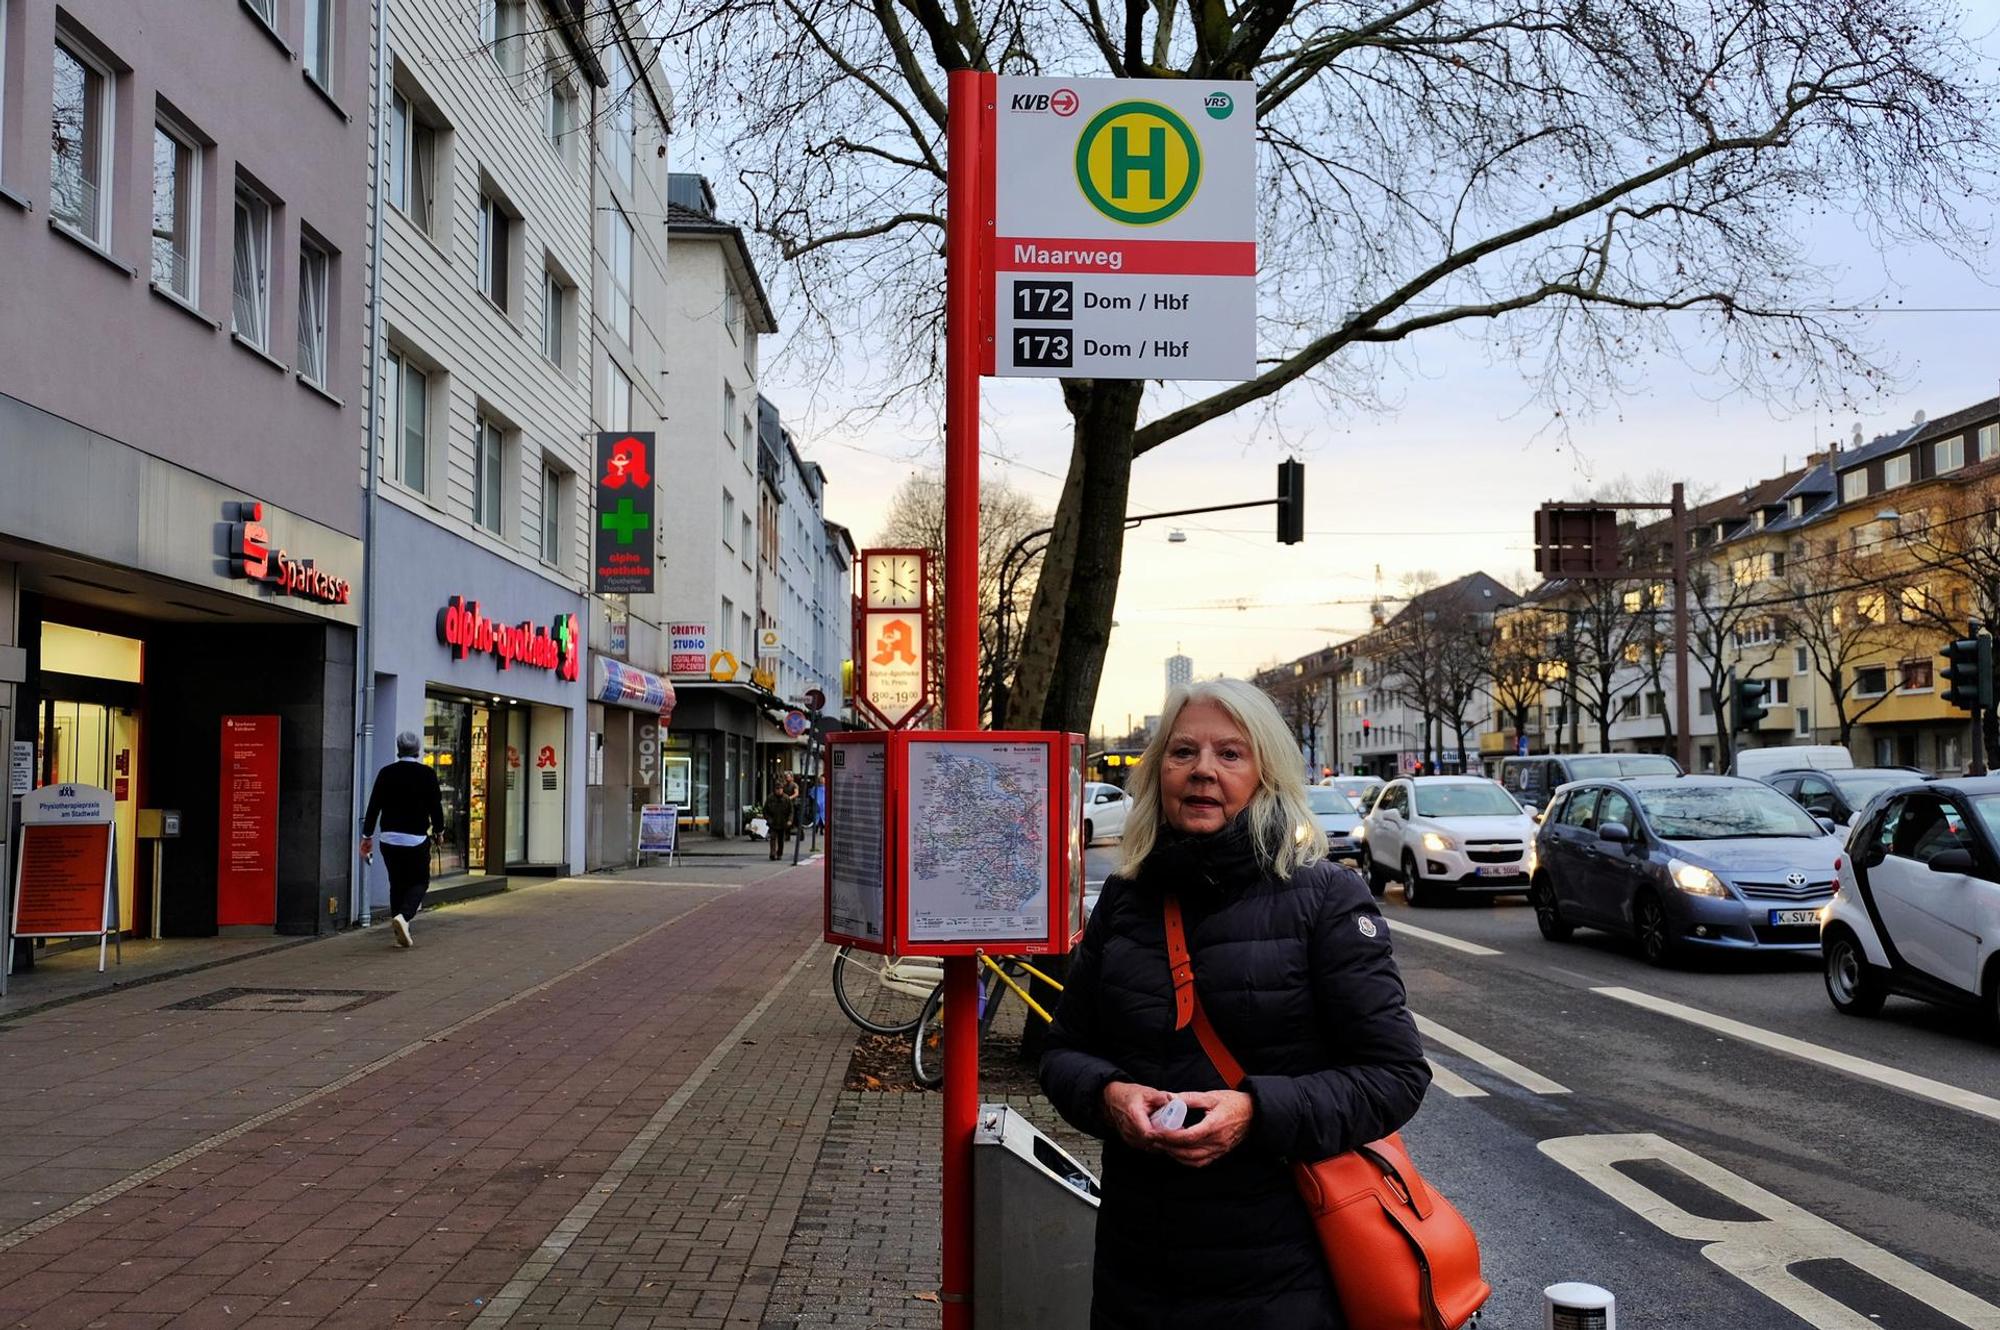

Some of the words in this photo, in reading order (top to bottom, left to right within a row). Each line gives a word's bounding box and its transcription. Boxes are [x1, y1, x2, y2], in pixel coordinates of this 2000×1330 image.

[1011, 94, 1049, 110] KVB
[1204, 97, 1227, 107] VRS
[1112, 126, 1165, 200] H
[1014, 244, 1122, 270] Maarweg
[1018, 288, 1069, 312] 172
[1084, 292, 1131, 309] Dom
[1154, 293, 1189, 310] Hbf
[1018, 336, 1069, 360] 173
[1084, 340, 1131, 357] Dom
[1154, 341, 1189, 357] Hbf
[608, 552, 641, 565] alpha
[277, 549, 351, 605] Sparkasse
[639, 725, 656, 785] COPY
[1778, 912, 1785, 922] K
[1792, 912, 1806, 922] SV
